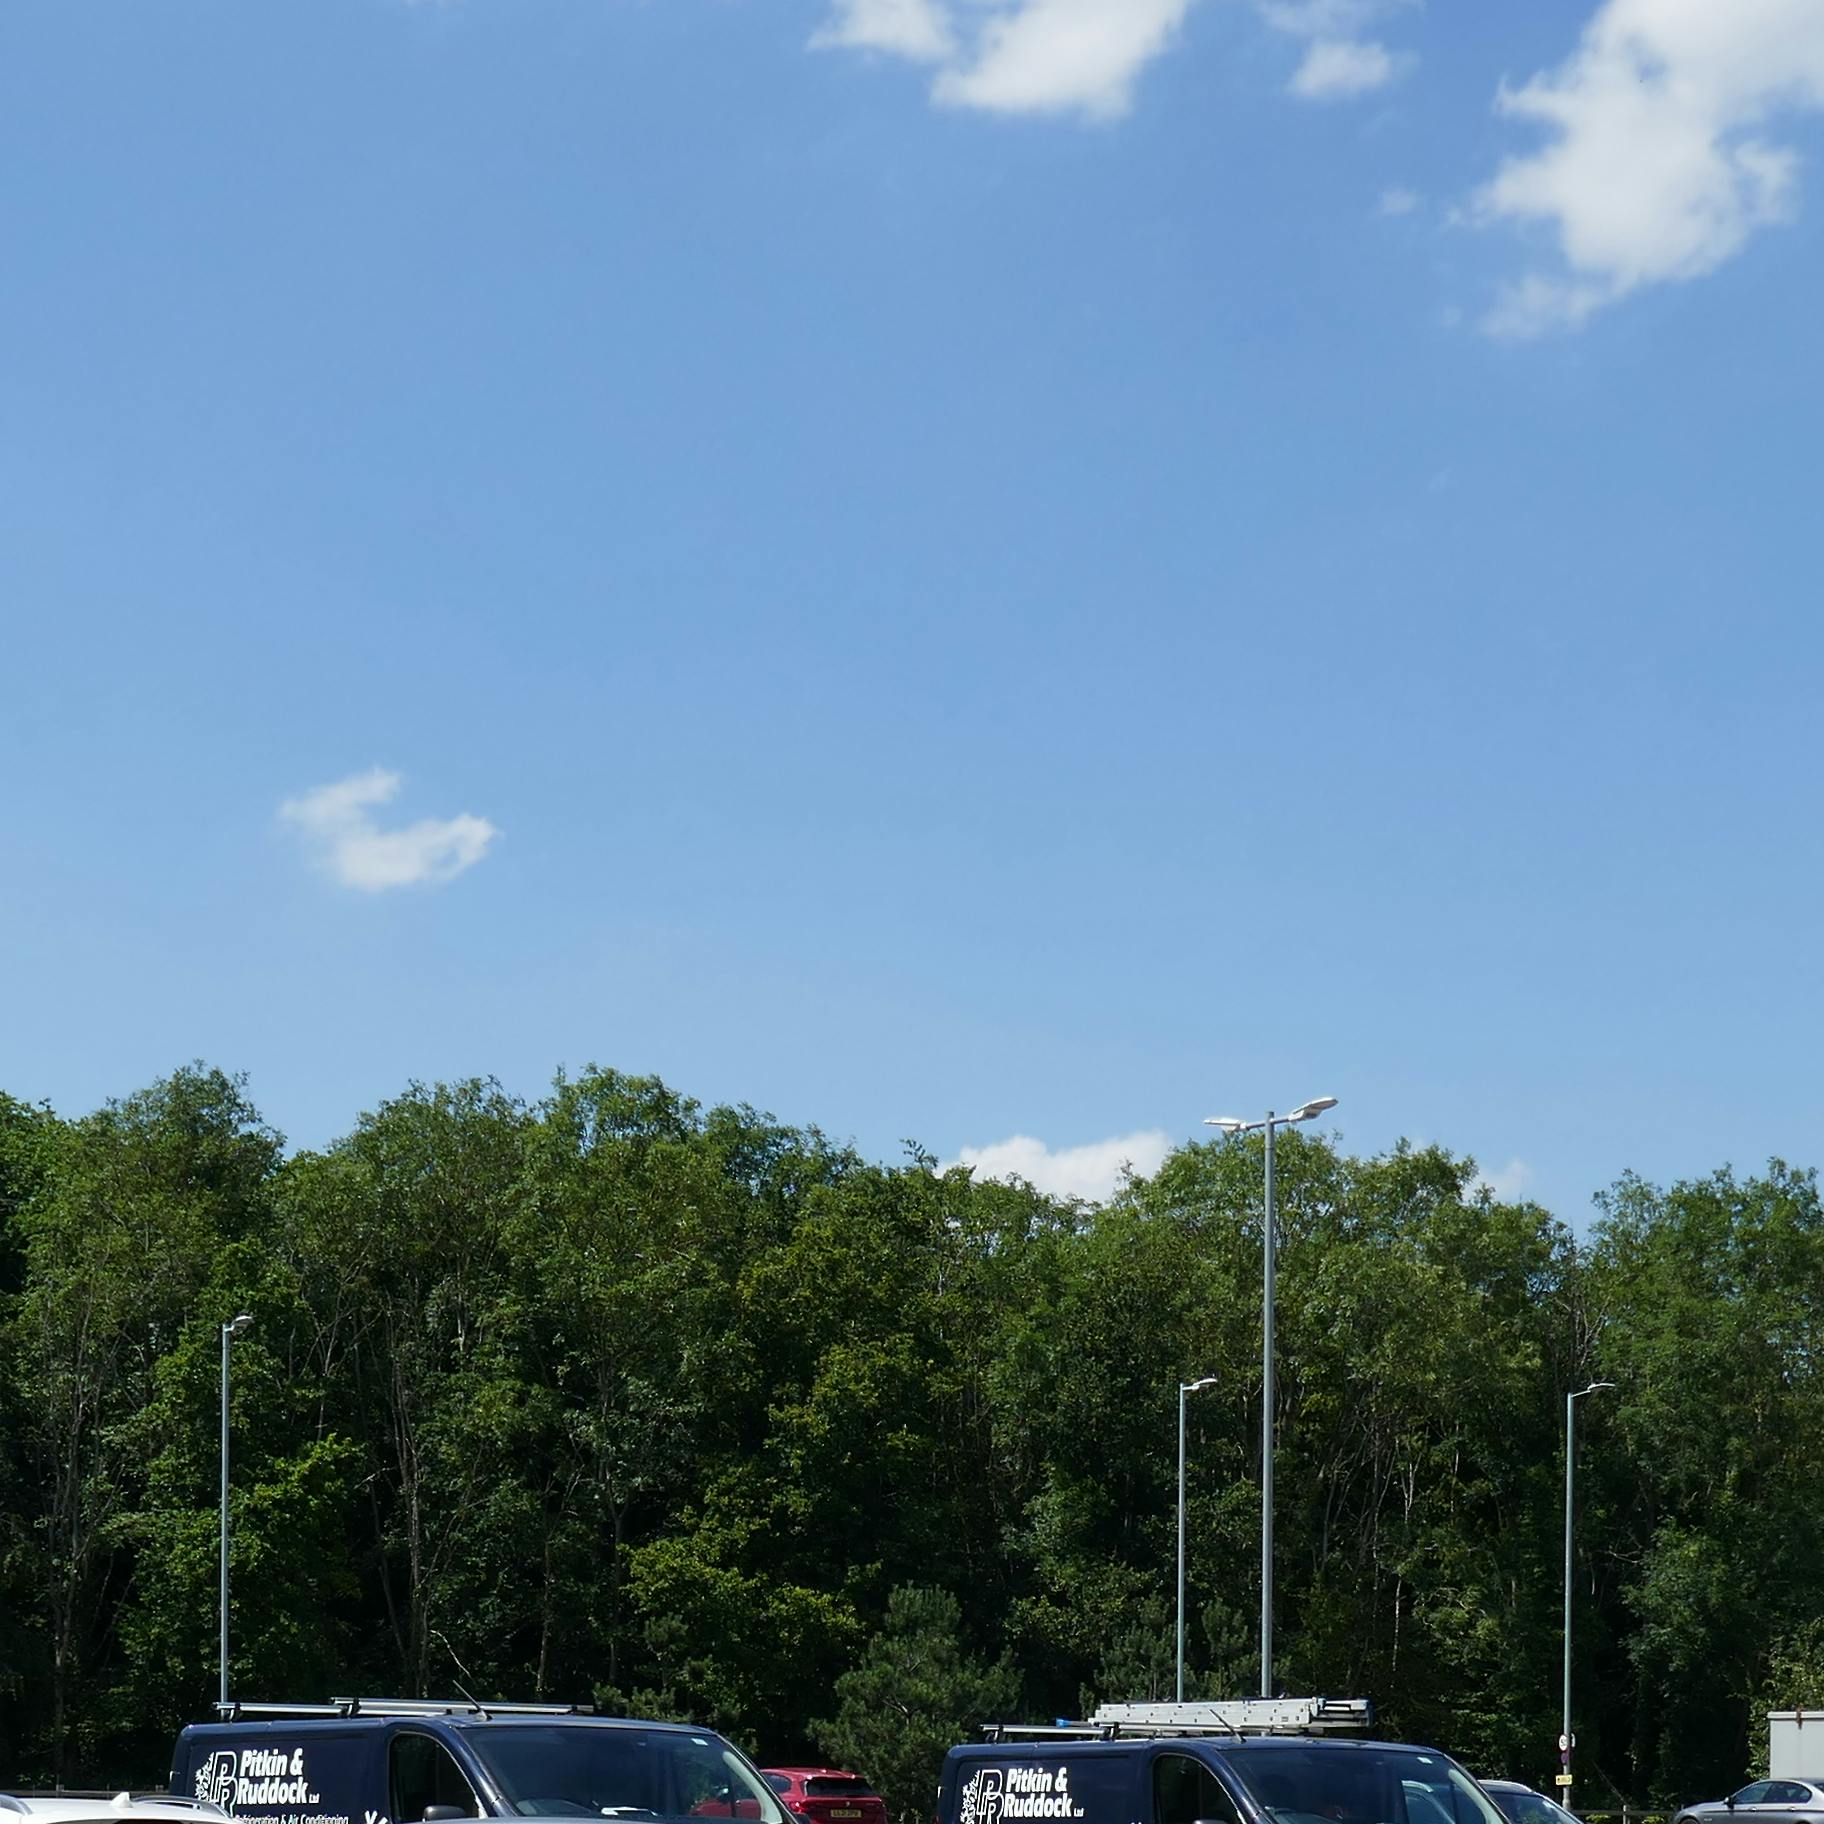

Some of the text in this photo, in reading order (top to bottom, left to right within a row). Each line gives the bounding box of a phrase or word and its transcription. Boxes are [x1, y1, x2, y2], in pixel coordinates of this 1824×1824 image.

[239, 1748, 304, 1777] Pitkin &
[236, 1777, 320, 1805] Ruddock Ltd
[1006, 1767, 1068, 1793] Pitkin &
[1004, 1793, 1084, 1818] Ruddock Ltd
